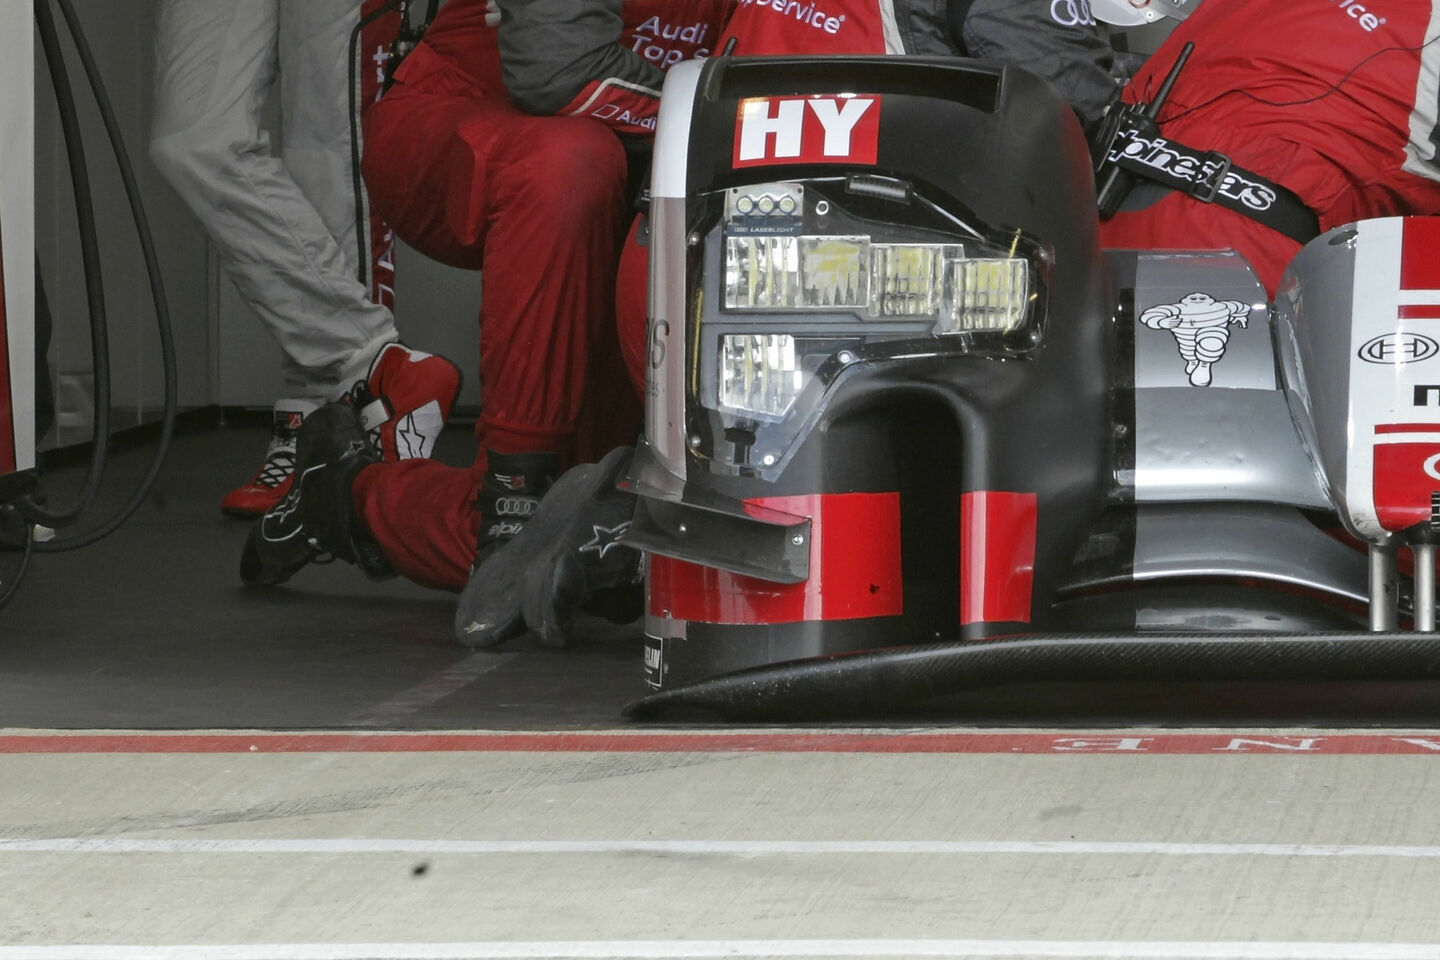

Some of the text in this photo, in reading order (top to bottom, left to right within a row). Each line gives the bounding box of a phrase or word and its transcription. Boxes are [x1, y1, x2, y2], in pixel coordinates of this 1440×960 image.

[635, 15, 710, 45] Audi
[631, 34, 685, 70] Top
[616, 109, 657, 131] Audi
[738, 98, 876, 162] HY
[750, 226, 795, 234] LASERLIGHT
